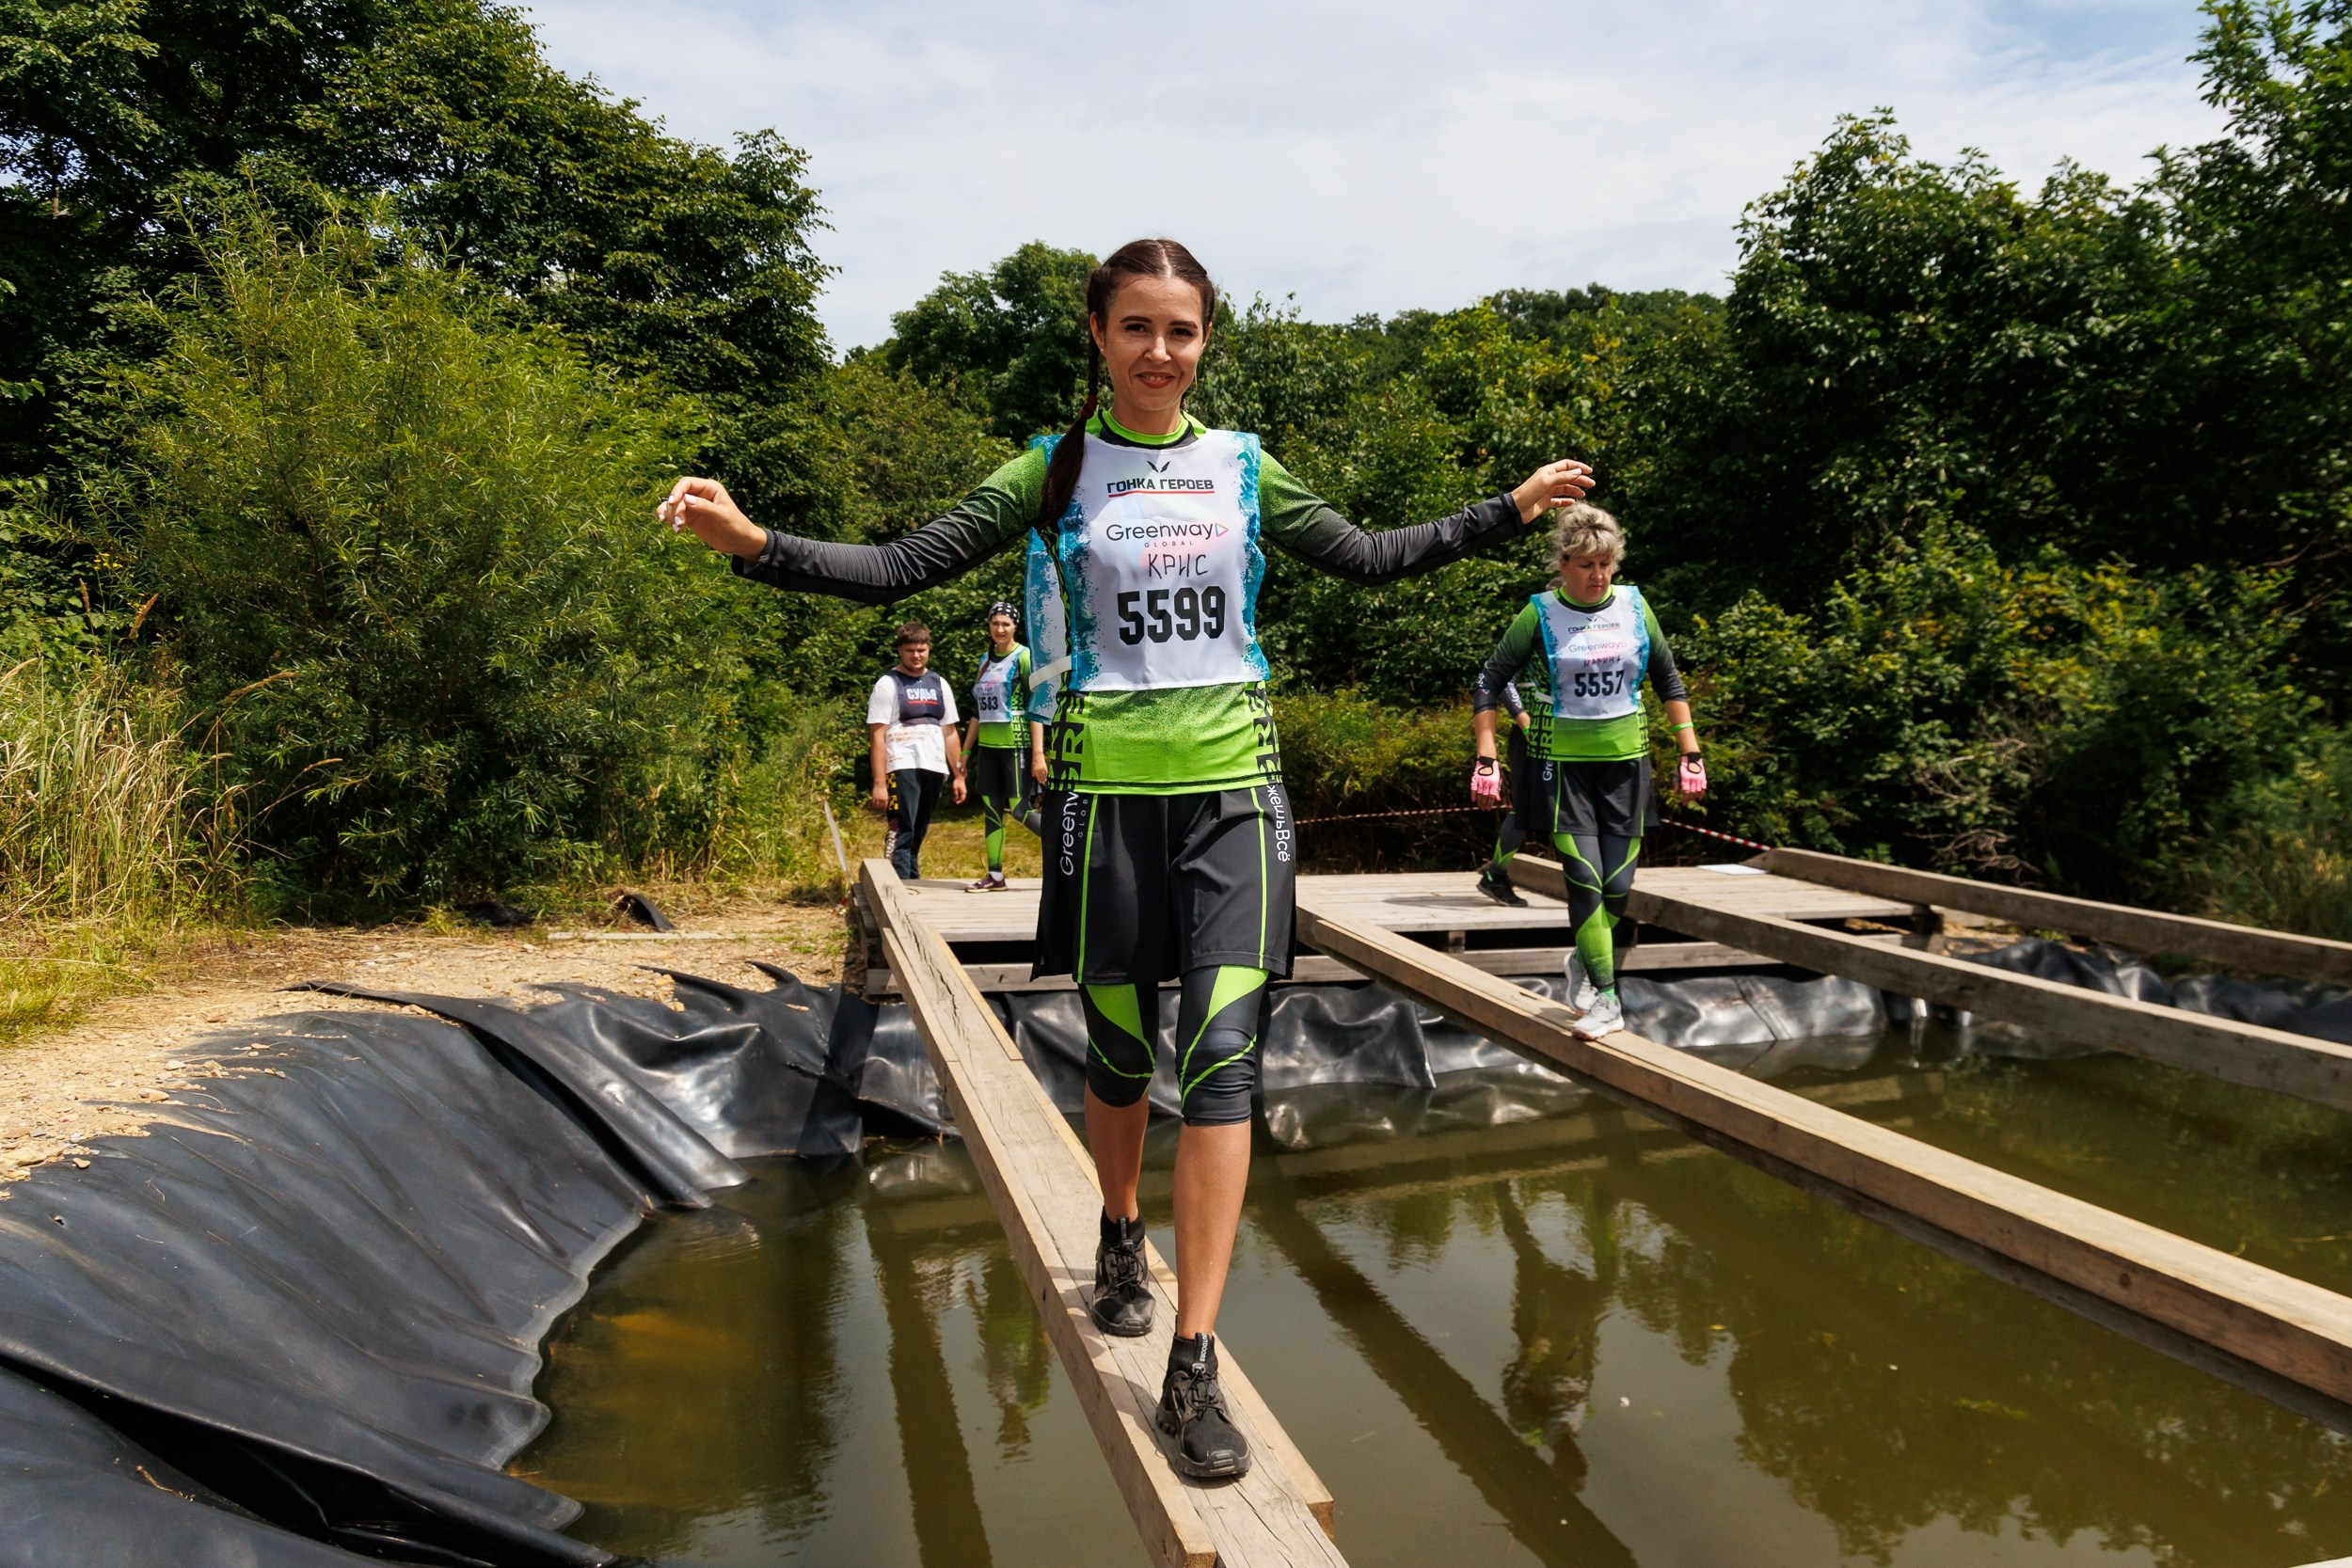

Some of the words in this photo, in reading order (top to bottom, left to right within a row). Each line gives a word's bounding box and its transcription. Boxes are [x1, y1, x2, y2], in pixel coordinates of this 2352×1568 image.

[1107, 477, 1155, 494] ГОНКА
[1160, 478, 1214, 490] ГЕРОЕВ
[1105, 522, 1214, 541] Greenway
[1144, 540, 1194, 548] GLOBAL
[1147, 553, 1210, 579] КРИС
[1117, 585, 1226, 646] 5599
[1574, 669, 1625, 697] 5557
[906, 688, 938, 702] СУДЬЯ
